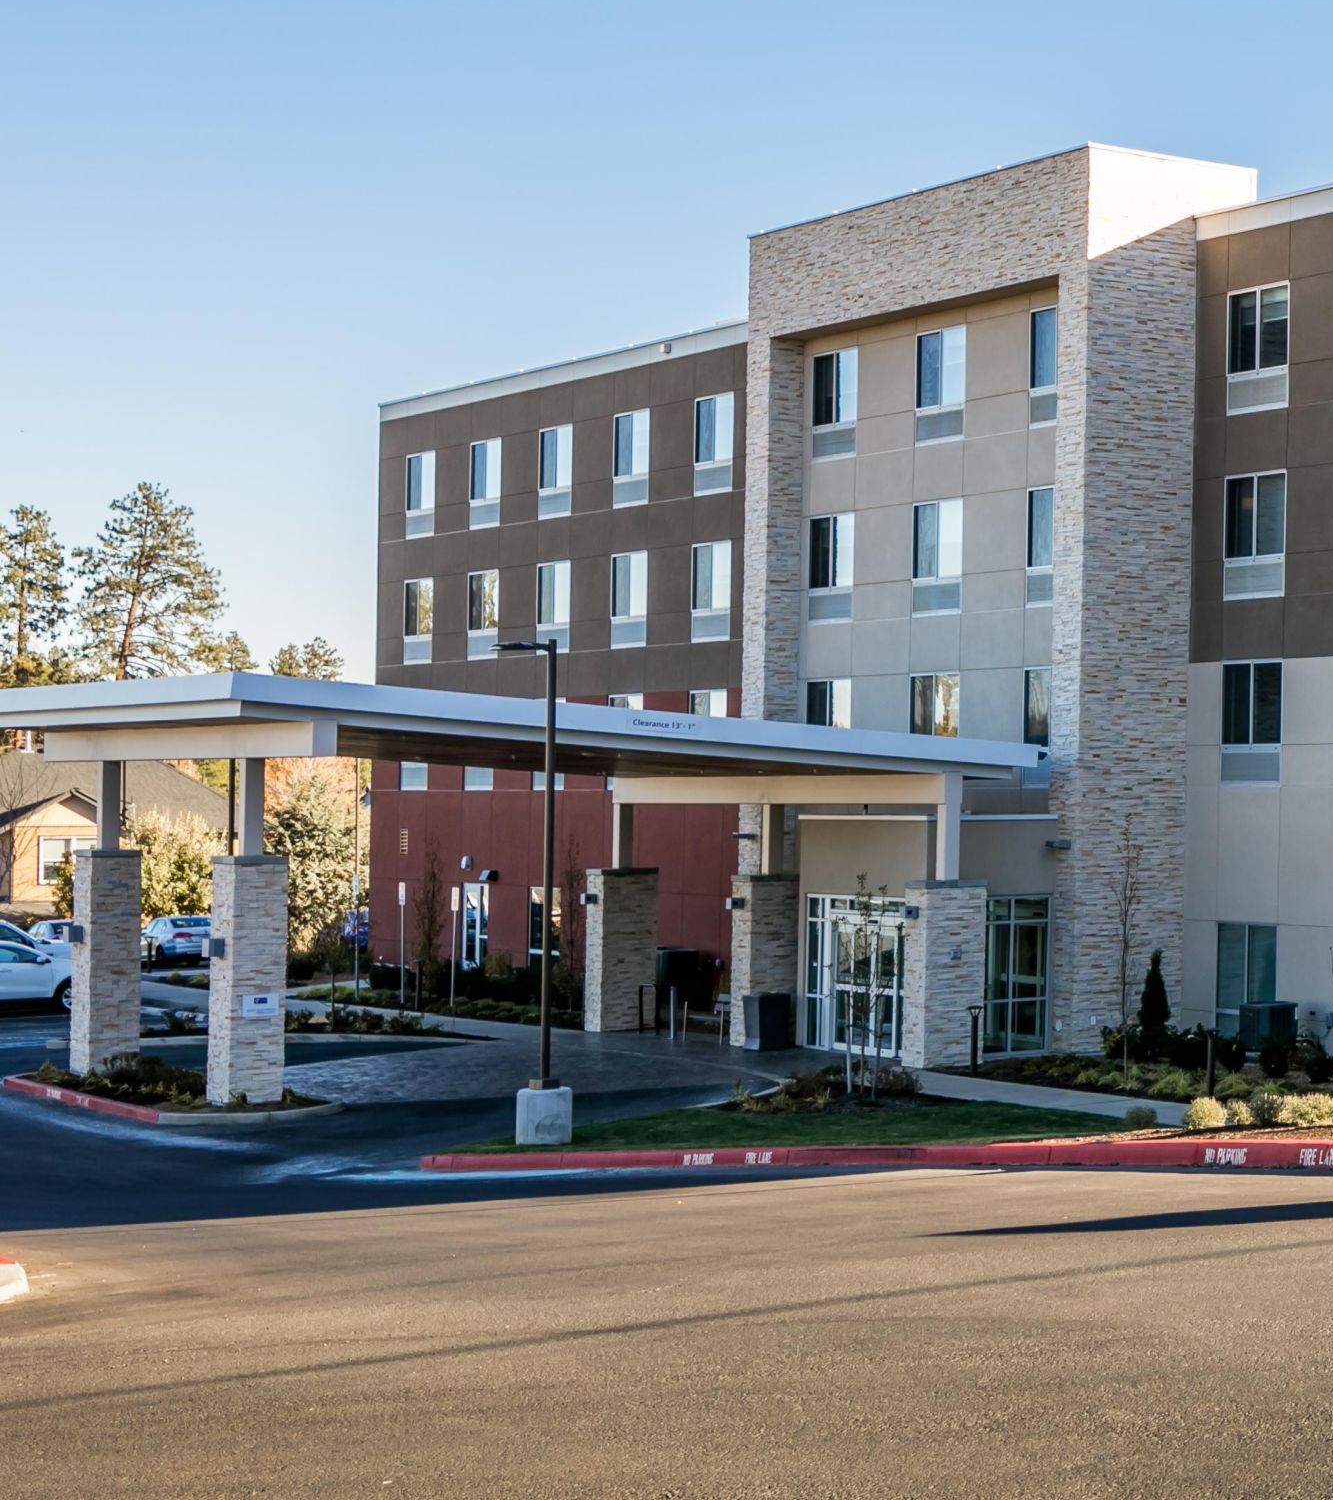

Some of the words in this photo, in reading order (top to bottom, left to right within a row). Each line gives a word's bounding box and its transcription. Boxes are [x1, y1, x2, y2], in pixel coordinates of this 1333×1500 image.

[632, 718, 669, 729] Clearance
[1204, 1148, 1216, 1164] NO
[1216, 1148, 1248, 1165] PARKING
[1299, 1148, 1317, 1166] FIRE
